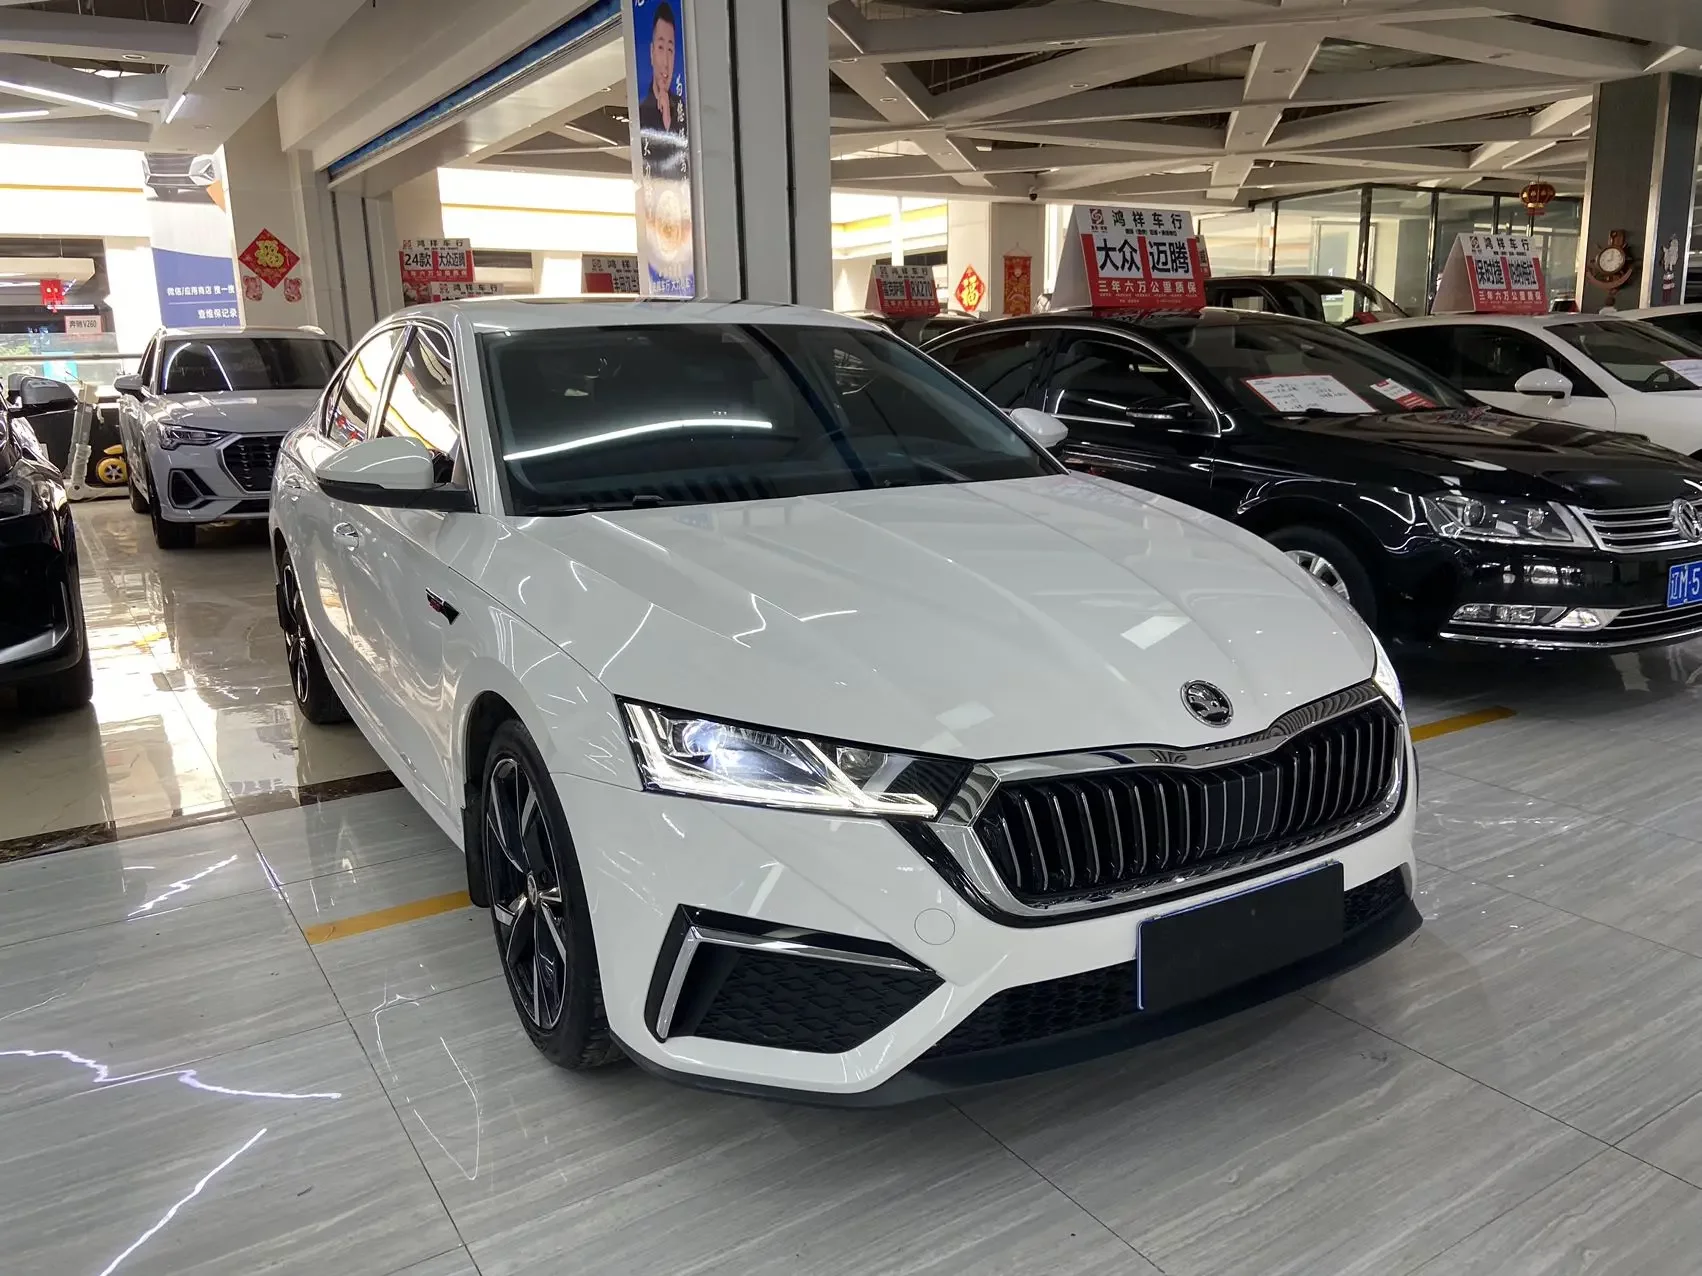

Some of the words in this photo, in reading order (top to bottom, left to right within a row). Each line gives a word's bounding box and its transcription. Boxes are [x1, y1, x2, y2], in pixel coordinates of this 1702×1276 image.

[1111, 209, 1183, 230] 鸿祥车行
[1483, 236, 1530, 251] 鸿祥车行
[404, 252, 432, 268] 24款
[1096, 238, 1141, 273] 大众
[1148, 240, 1190, 274] 迈腾
[1475, 259, 1505, 286] 保时捷
[1097, 280, 1198, 294] 三年六万公里质保
